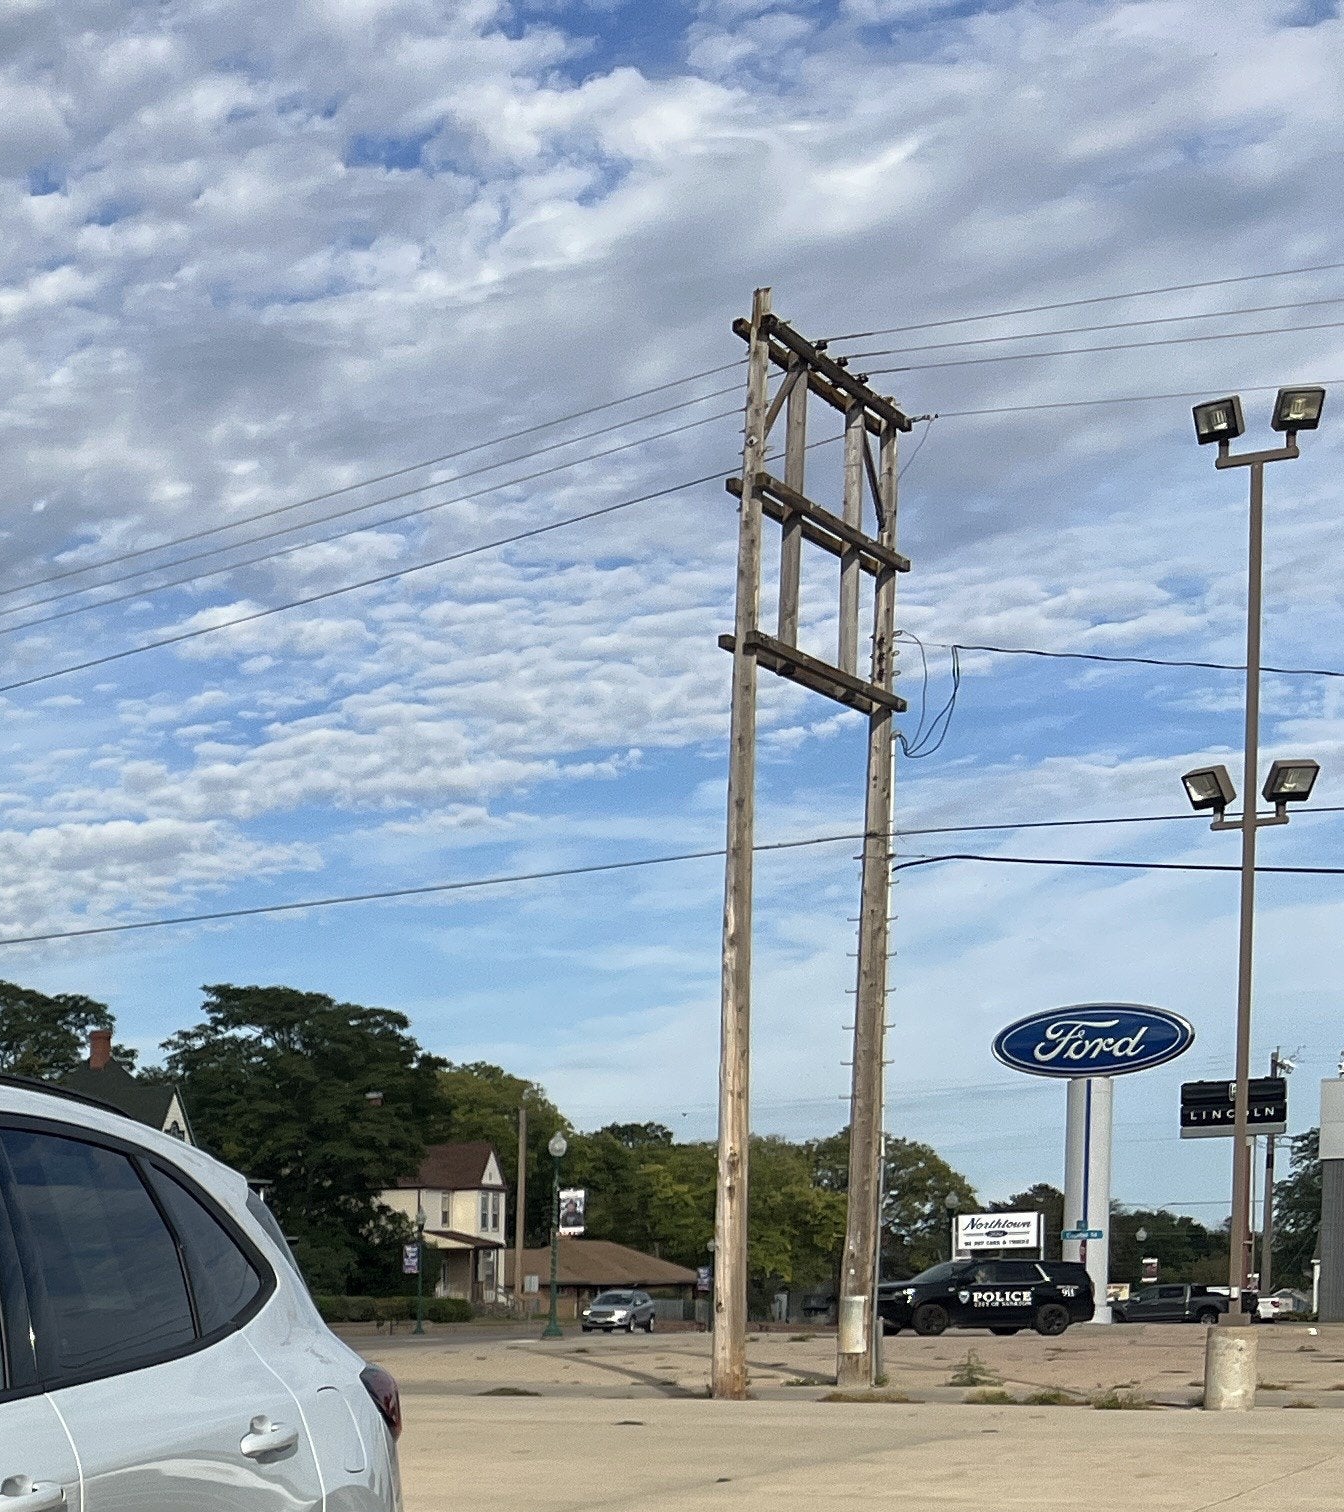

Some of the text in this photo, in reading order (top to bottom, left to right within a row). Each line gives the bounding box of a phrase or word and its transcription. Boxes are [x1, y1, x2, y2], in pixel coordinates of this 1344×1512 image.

[1034, 1019, 1148, 1063] Ford
[1190, 1106, 1275, 1121] LINCLN
[963, 1217, 1031, 1231] Northtown
[972, 1291, 1032, 1302] POLICE
